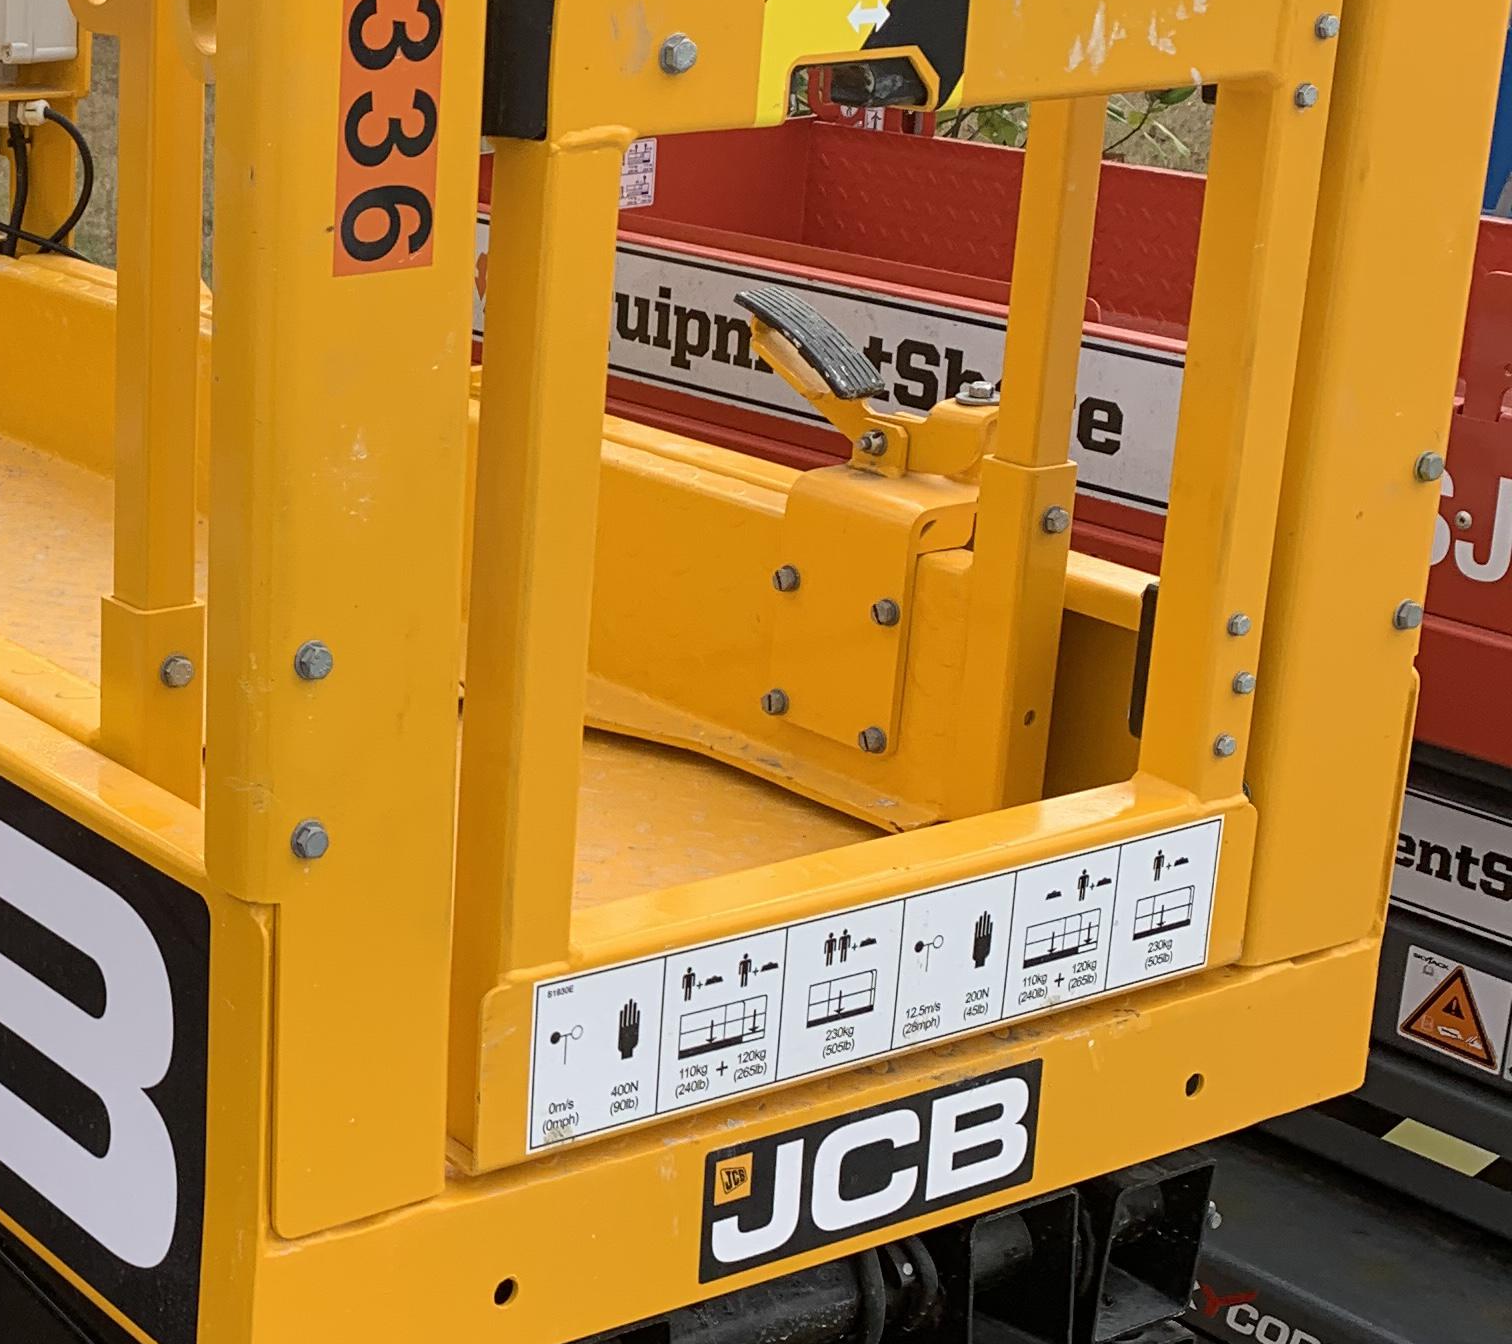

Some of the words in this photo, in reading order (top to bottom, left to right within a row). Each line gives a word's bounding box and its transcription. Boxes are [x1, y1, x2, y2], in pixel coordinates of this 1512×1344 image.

[1147, 939, 1173, 954] 230kg
[1072, 959, 1097, 974] 120kg
[1144, 951, 1173, 970] (505lb)
[1022, 973, 1048, 988] 110kg
[1068, 972, 1098, 992] (265lb)
[965, 987, 990, 1004] 200N
[1018, 986, 1048, 1005] (240lb)
[905, 1001, 941, 1019] 12.5m/s
[963, 1002, 989, 1021] (45lb)
[825, 1026, 855, 1042] 230kg
[737, 1048, 767, 1066] 120kg
[822, 1038, 855, 1059] (505lb)
[679, 1064, 708, 1081] 110kg
[733, 1062, 768, 1082] (265lb)
[611, 1080, 639, 1098] 400N
[674, 1078, 710, 1099] (240lb)
[548, 1099, 575, 1115] 0m/s
[609, 1097, 639, 1117] (90lb)
[542, 1112, 579, 1135] (0mph)
[712, 1077, 1029, 1263] JCB
[724, 1167, 746, 1191] JCB
